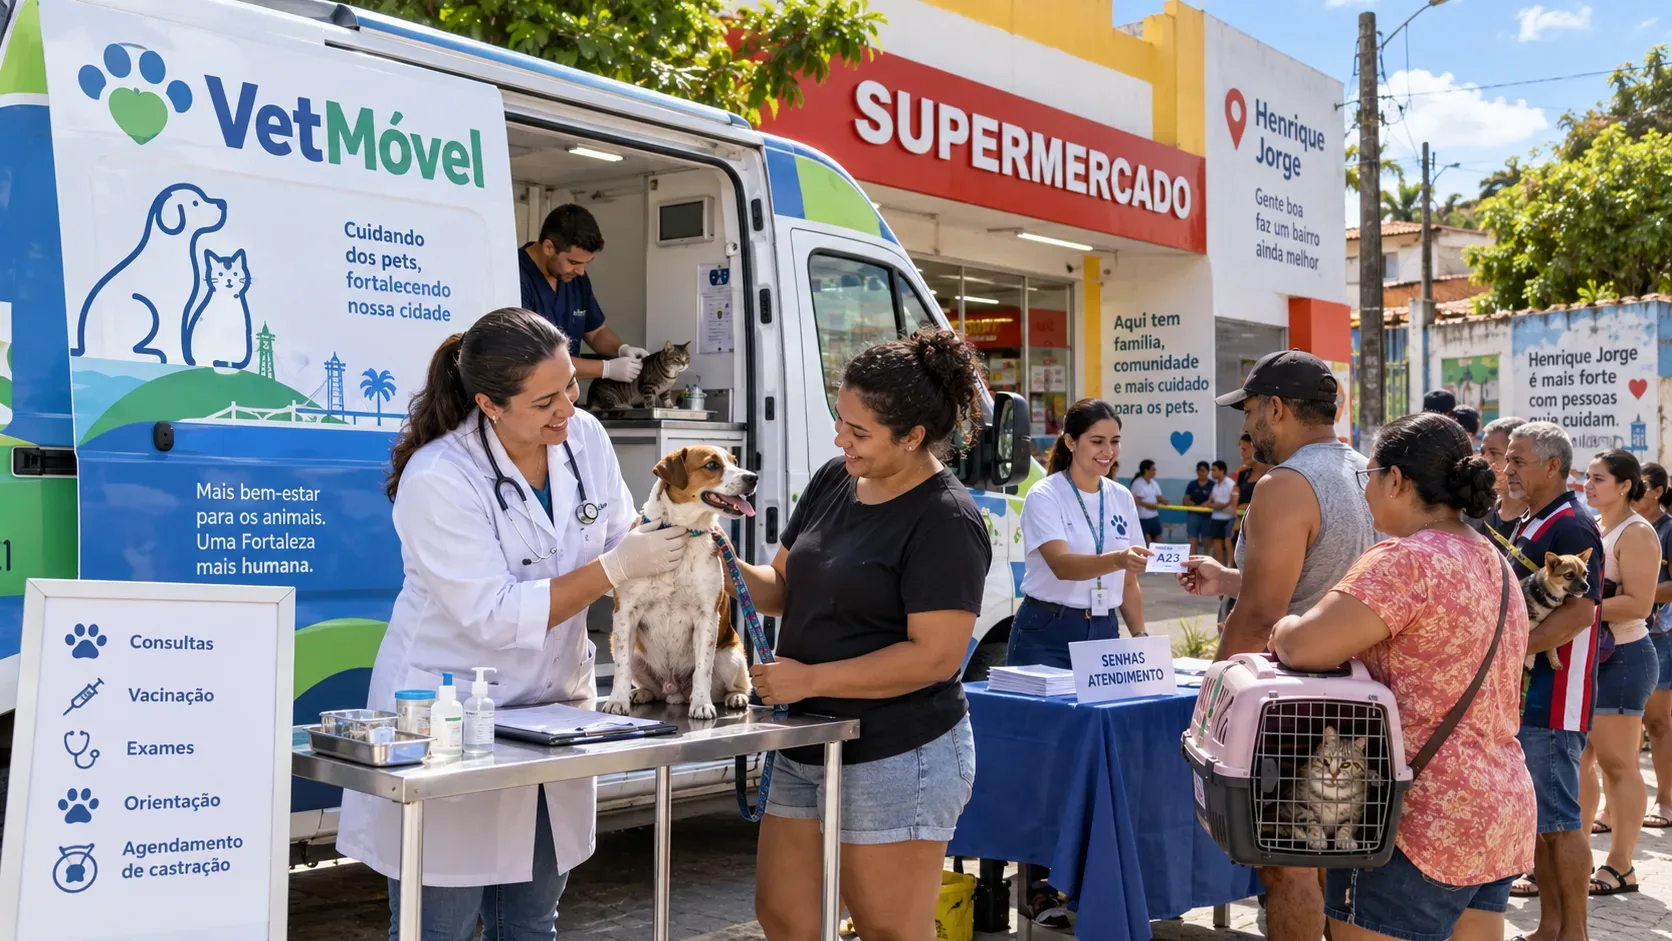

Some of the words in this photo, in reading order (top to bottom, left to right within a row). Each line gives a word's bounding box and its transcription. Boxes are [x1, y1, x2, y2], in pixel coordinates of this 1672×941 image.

[204, 74, 485, 188] VetMóvel
[1256, 99, 1325, 152] Henrique
[854, 80, 1191, 220] SUPERMERCADO
[1256, 137, 1301, 180] Jorge
[1256, 188, 1284, 212] Gente
[1287, 197, 1303, 218] boa
[345, 222, 425, 247] Cuidando
[1256, 212, 1271, 233] faz
[1274, 223, 1289, 238] um
[1293, 222, 1320, 246] bairro
[346, 246, 376, 265] dos
[382, 254, 421, 273] pets,
[1256, 240, 1283, 262] ainda
[1287, 248, 1320, 271] melhor
[346, 271, 451, 298] fortalecendo
[348, 301, 394, 317] nossa
[400, 302, 450, 321] cidade
[1114, 313, 1146, 332] Aqui
[1151, 314, 1180, 327] tem
[1114, 335, 1164, 351] família,
[1114, 353, 1199, 372] comunidade
[1529, 350, 1591, 369] Henrique
[1596, 347, 1637, 365] Jorge
[1114, 383, 1121, 393] e
[1126, 378, 1154, 393] mais
[1158, 376, 1209, 392] cuidado
[1529, 373, 1537, 388] é
[1542, 372, 1574, 387] mais
[1579, 369, 1616, 385] forte
[1147, 403, 1162, 414] os
[1166, 400, 1198, 417] pets.
[1529, 396, 1557, 407] com
[1562, 393, 1617, 410] pessoas
[1563, 411, 1618, 427] cuidam.
[197, 483, 234, 499] Mais
[241, 483, 320, 501] bem-estar
[197, 511, 234, 526] para
[240, 512, 257, 524] os
[263, 509, 325, 524] animais.
[197, 533, 235, 550] Uma
[243, 533, 315, 549] Fortaleza
[197, 558, 236, 575] mais
[242, 557, 313, 573] humana.
[1156, 553, 1180, 563] A23
[131, 635, 213, 650] Consultas
[1102, 652, 1145, 667] SENHAS
[1088, 668, 1164, 688] ATENDIMENTO
[129, 688, 214, 705] Vacinação
[127, 741, 194, 755] Exames
[125, 793, 220, 811] Orientação
[123, 836, 243, 858] Agendamento
[122, 863, 144, 878] de
[149, 858, 230, 876] castração
